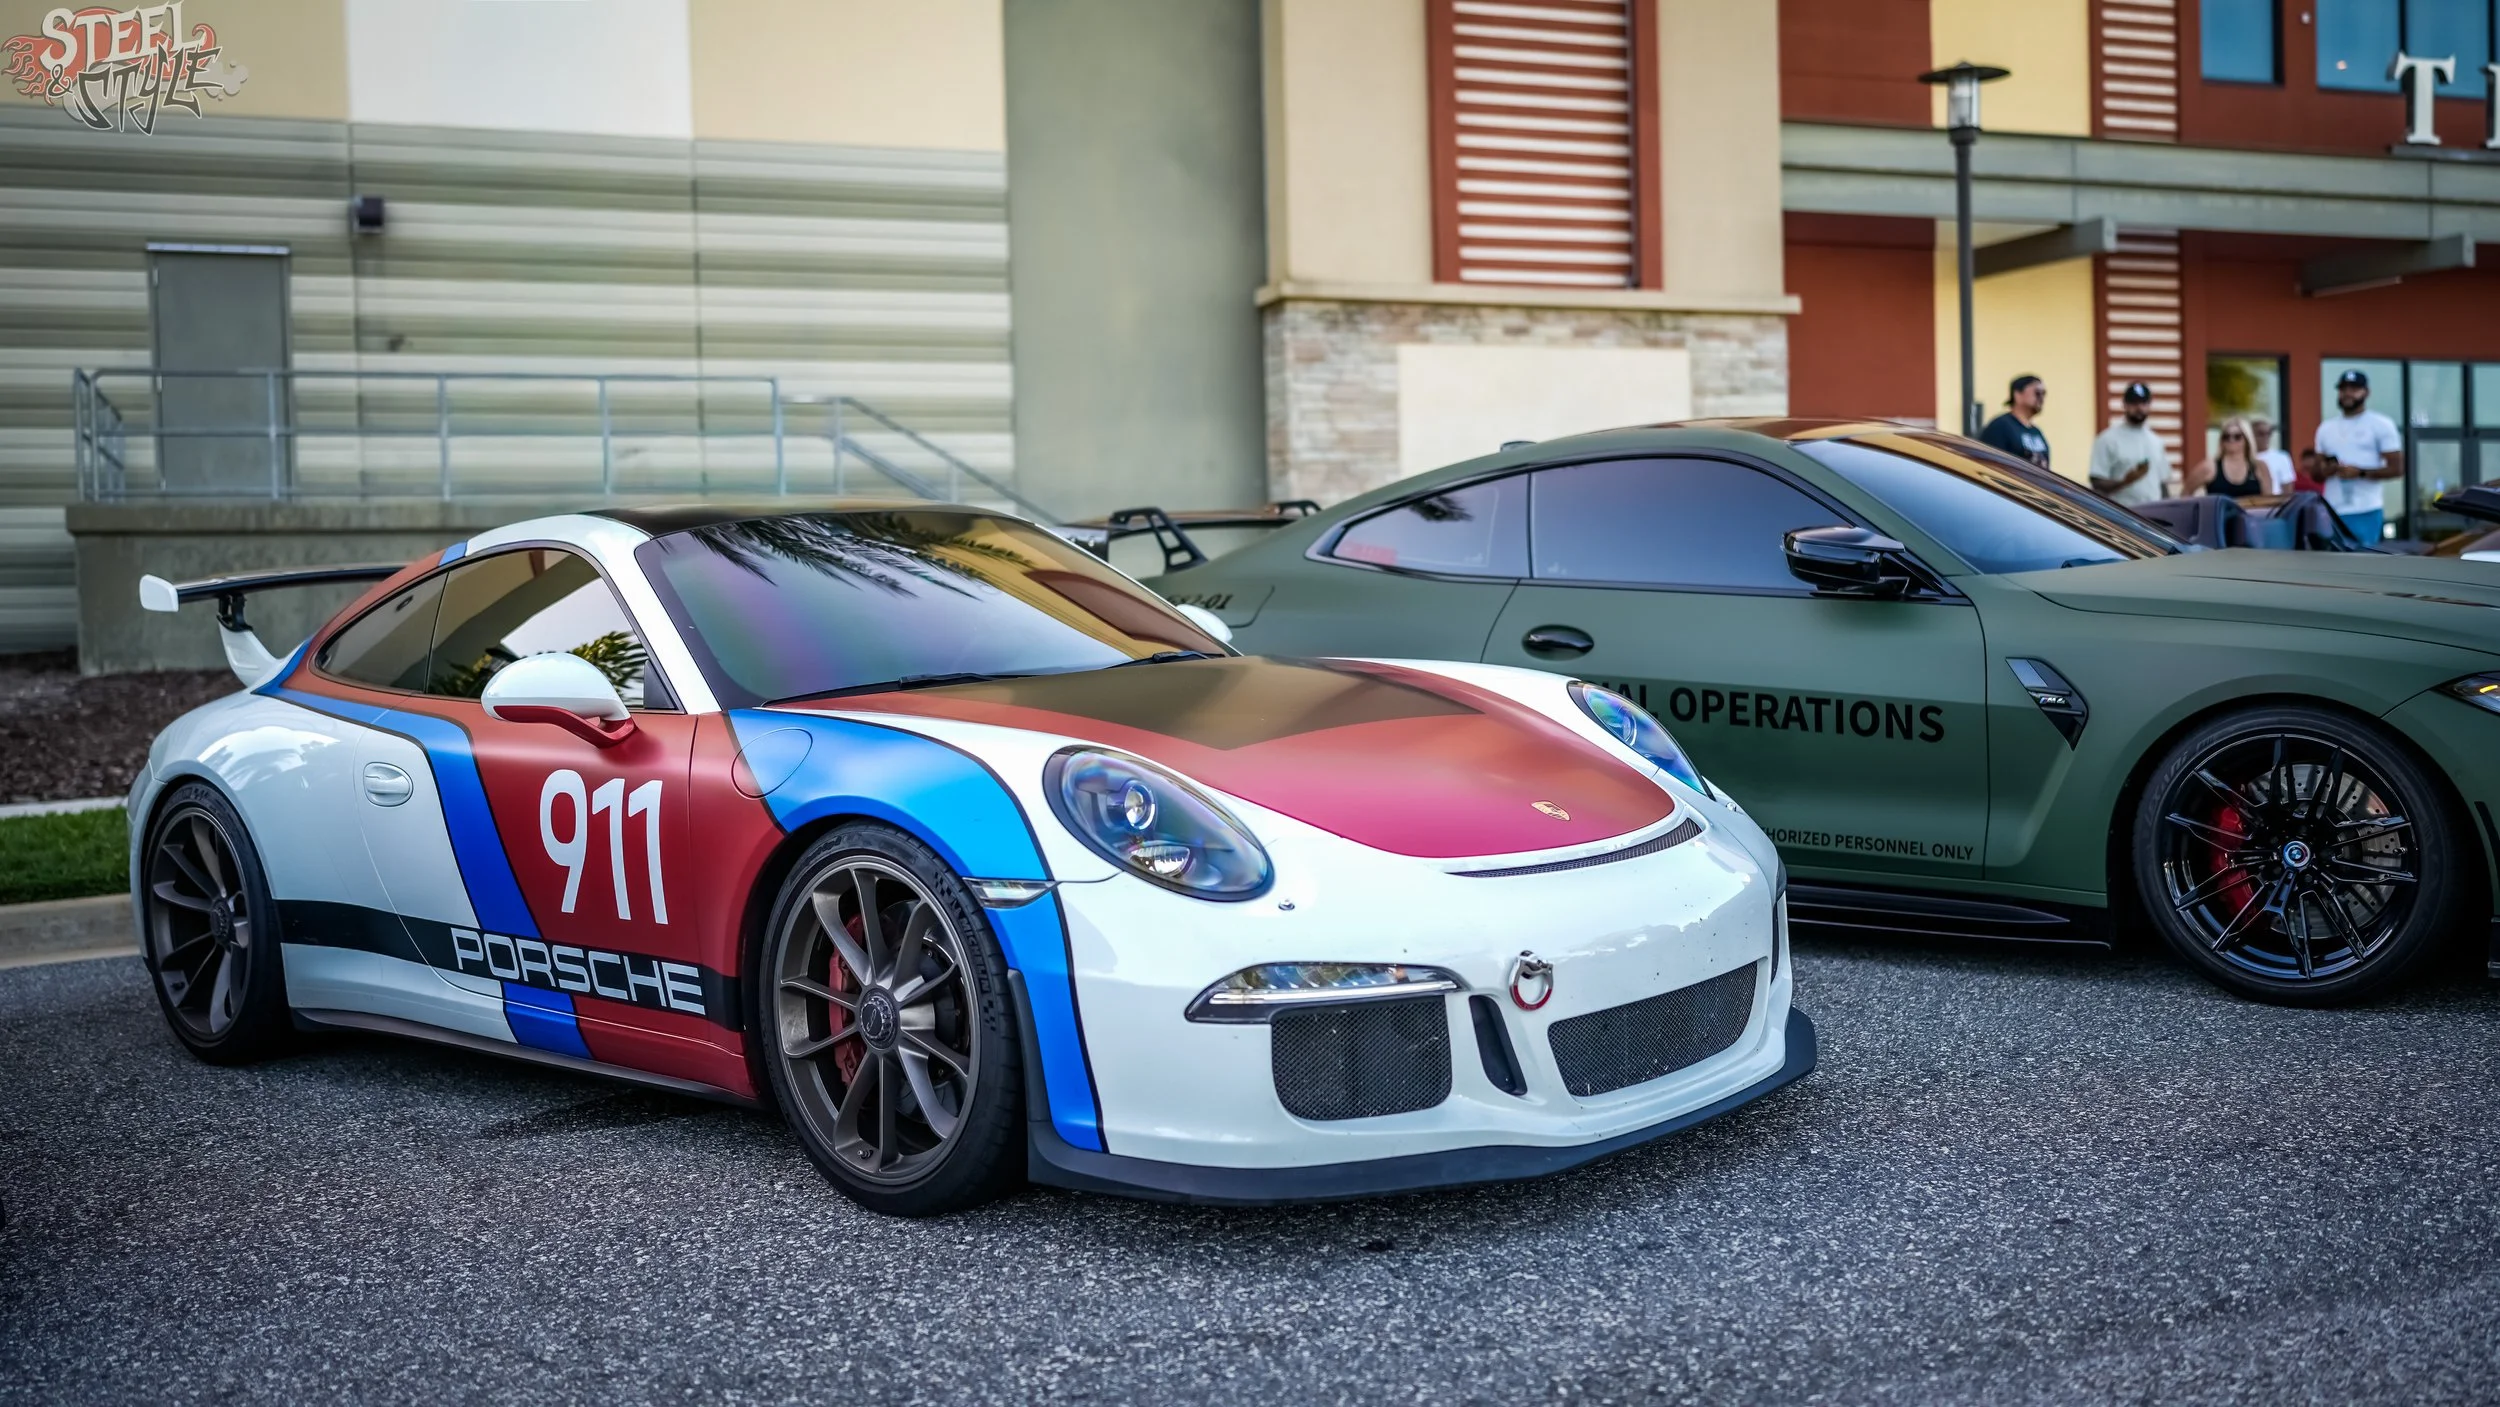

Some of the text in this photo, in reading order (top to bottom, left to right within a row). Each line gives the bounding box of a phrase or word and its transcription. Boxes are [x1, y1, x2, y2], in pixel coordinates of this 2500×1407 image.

[1669, 686, 1945, 743] OPERATIONS
[540, 769, 669, 925] 911
[1835, 834, 1928, 856] PERSONNEL
[1932, 842, 1974, 861] ONLY
[450, 927, 706, 1016] PORSCHE
